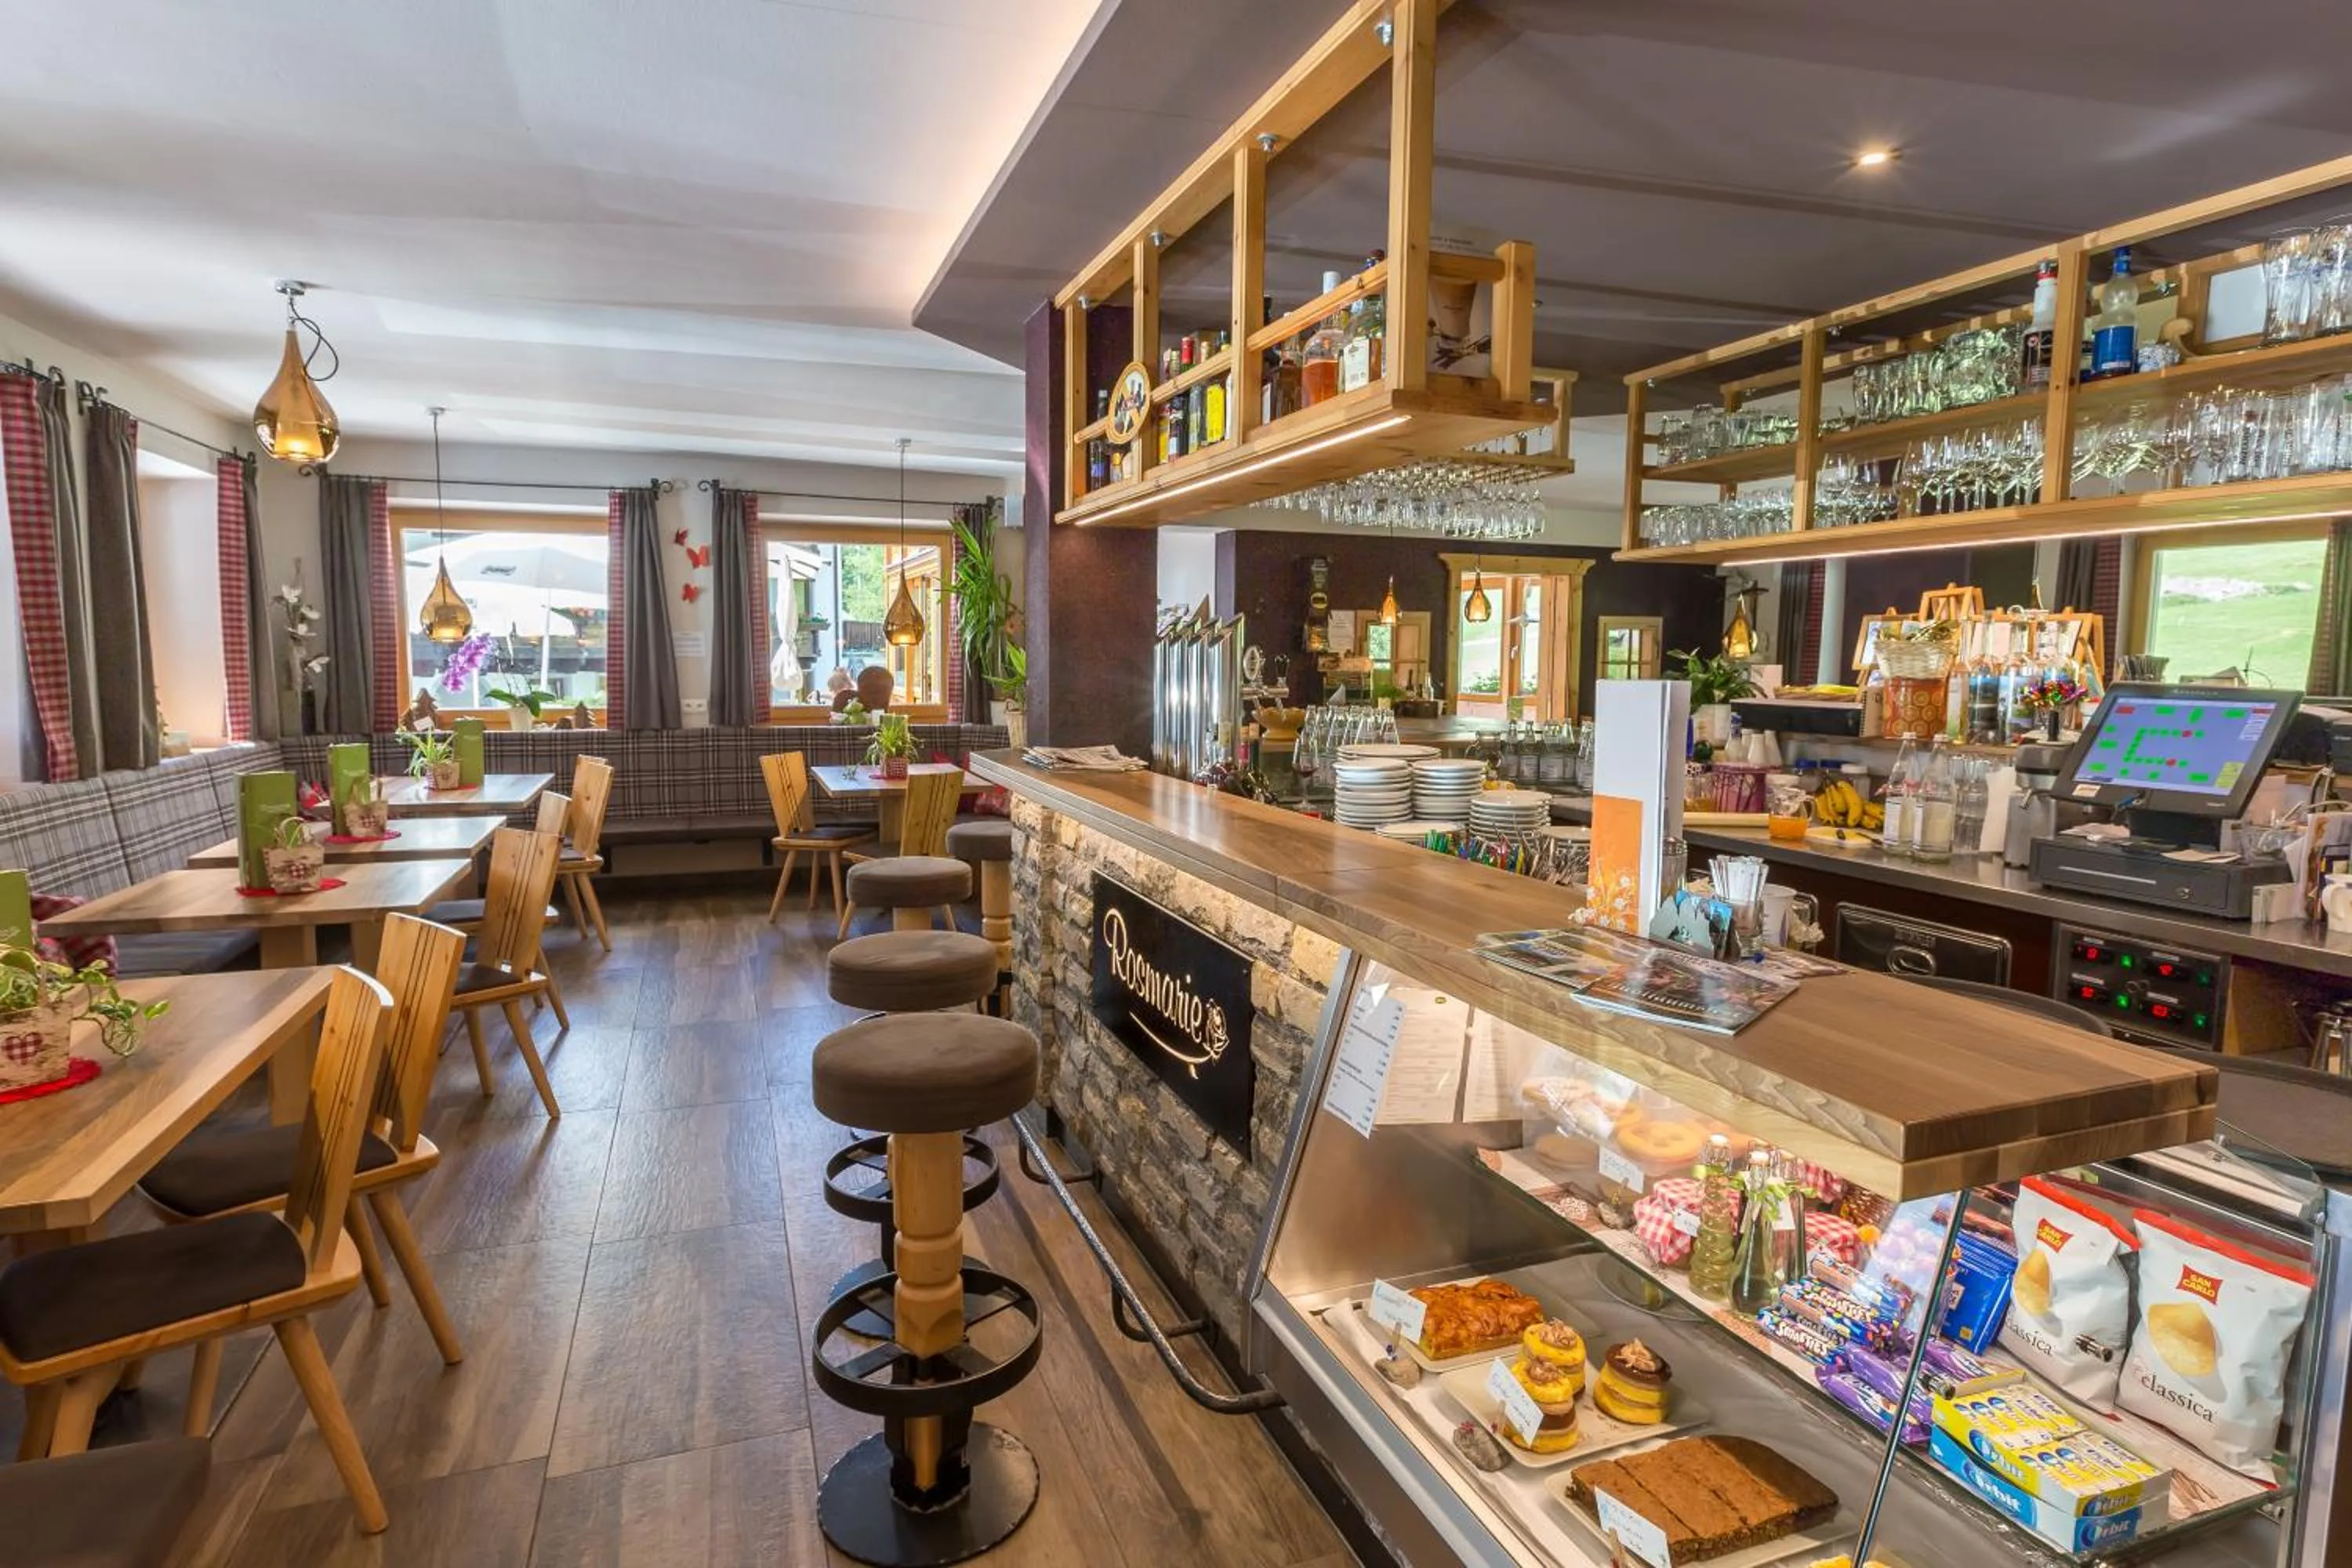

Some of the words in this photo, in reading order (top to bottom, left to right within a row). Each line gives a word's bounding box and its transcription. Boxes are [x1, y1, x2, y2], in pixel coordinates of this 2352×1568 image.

[1103, 908, 1202, 1044] Rosmarie
[2182, 1279, 2216, 1298] CARLO
[2190, 1273, 2212, 1288] SAN
[2141, 1374, 2214, 1423] classica
[1962, 1460, 2021, 1512] Orbit
[2080, 1519, 2129, 1548] Orbit
